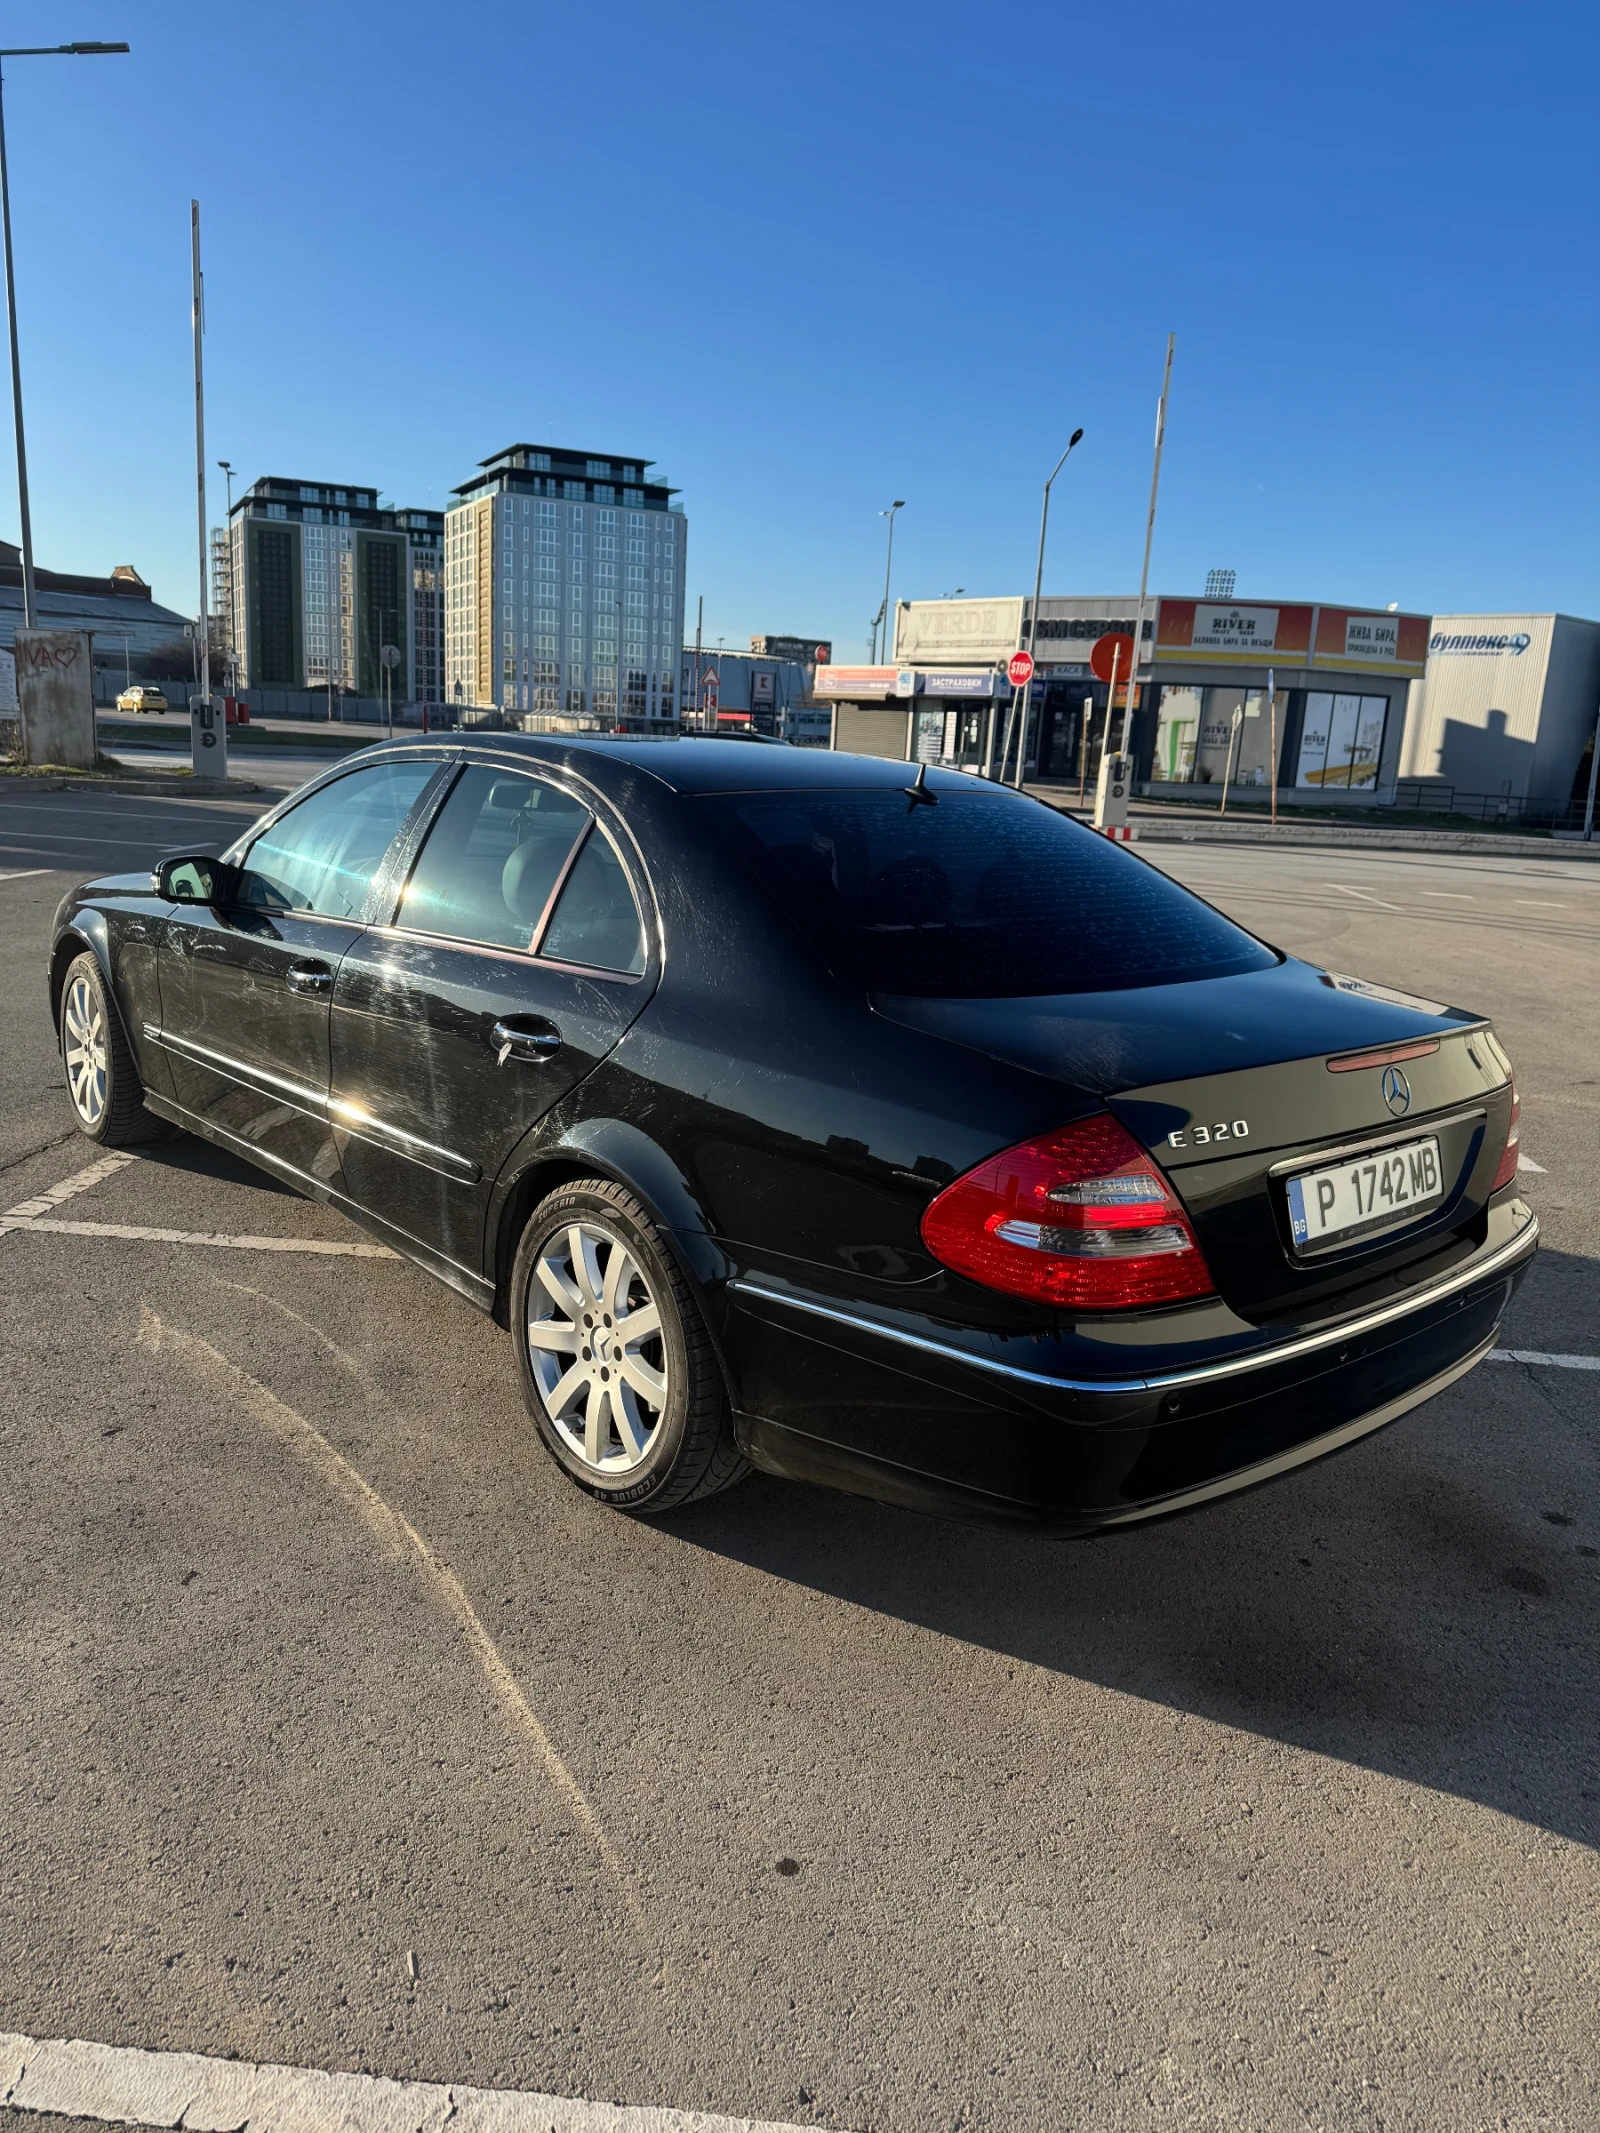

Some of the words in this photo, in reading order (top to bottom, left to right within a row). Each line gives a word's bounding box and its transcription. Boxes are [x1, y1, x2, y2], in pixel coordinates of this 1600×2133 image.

[919, 611, 997, 635] VERDE
[1213, 618, 1256, 630] RIVER
[1349, 625, 1371, 640] ЖИВА
[1010, 661, 1031, 675] STOP
[931, 678, 982, 687] ЗАСТРАХОВКИ
[1167, 1130, 1188, 1149] E
[1191, 1119, 1249, 1145] 320
[537, 1195, 577, 1223] SUPERIA
[1316, 1178, 1336, 1229] P
[1293, 1218, 1307, 1236] BG
[612, 1472, 657, 1502] ECOBLUE
